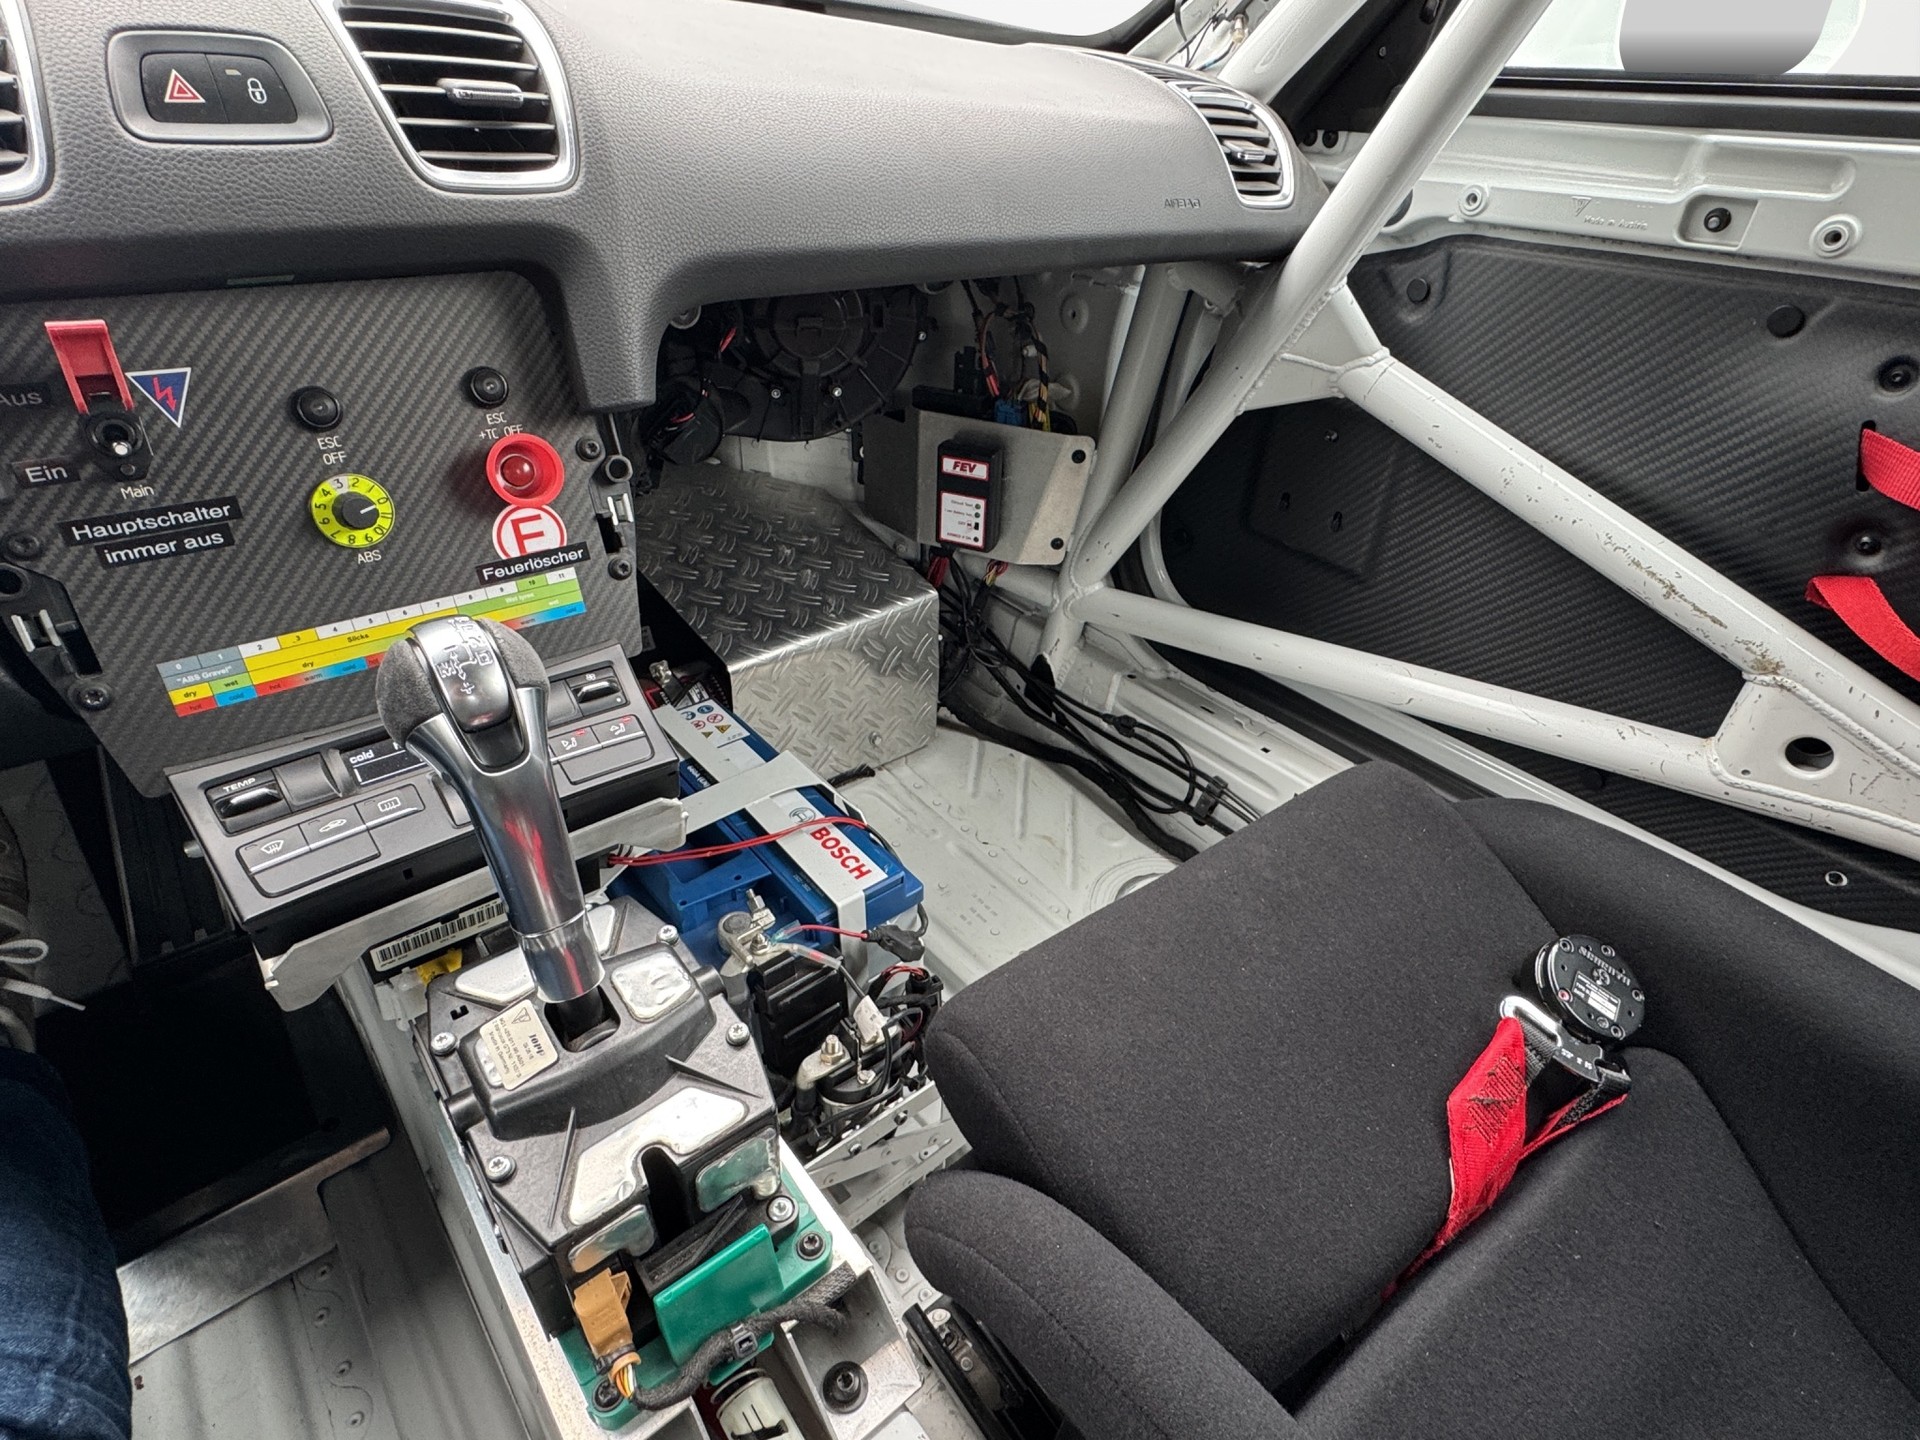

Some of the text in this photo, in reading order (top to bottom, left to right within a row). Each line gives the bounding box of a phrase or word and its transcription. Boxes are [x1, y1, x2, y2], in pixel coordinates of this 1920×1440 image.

[486, 412, 507, 425] ESC
[479, 424, 524, 440] +TC OFF
[317, 436, 342, 450] ESC
[322, 451, 347, 465] OFF
[24, 465, 68, 482] Ein
[952, 461, 976, 473] FEV
[334, 478, 344, 489] 3
[352, 478, 360, 488] 2
[120, 484, 154, 500] Main
[321, 488, 332, 497] 4
[377, 496, 389, 505] 0
[72, 504, 231, 541] Hauptschalter
[330, 530, 340, 539] 7
[348, 534, 356, 544] 8
[365, 533, 374, 542] 9
[510, 513, 545, 555] F
[104, 532, 224, 564] immer aus
[357, 549, 381, 564] ABS
[482, 548, 584, 581] Feuerlöscher
[347, 634, 369, 642] Slicks
[349, 749, 375, 764] cold
[222, 777, 256, 793] TEMP
[810, 826, 872, 880] BOSCH
